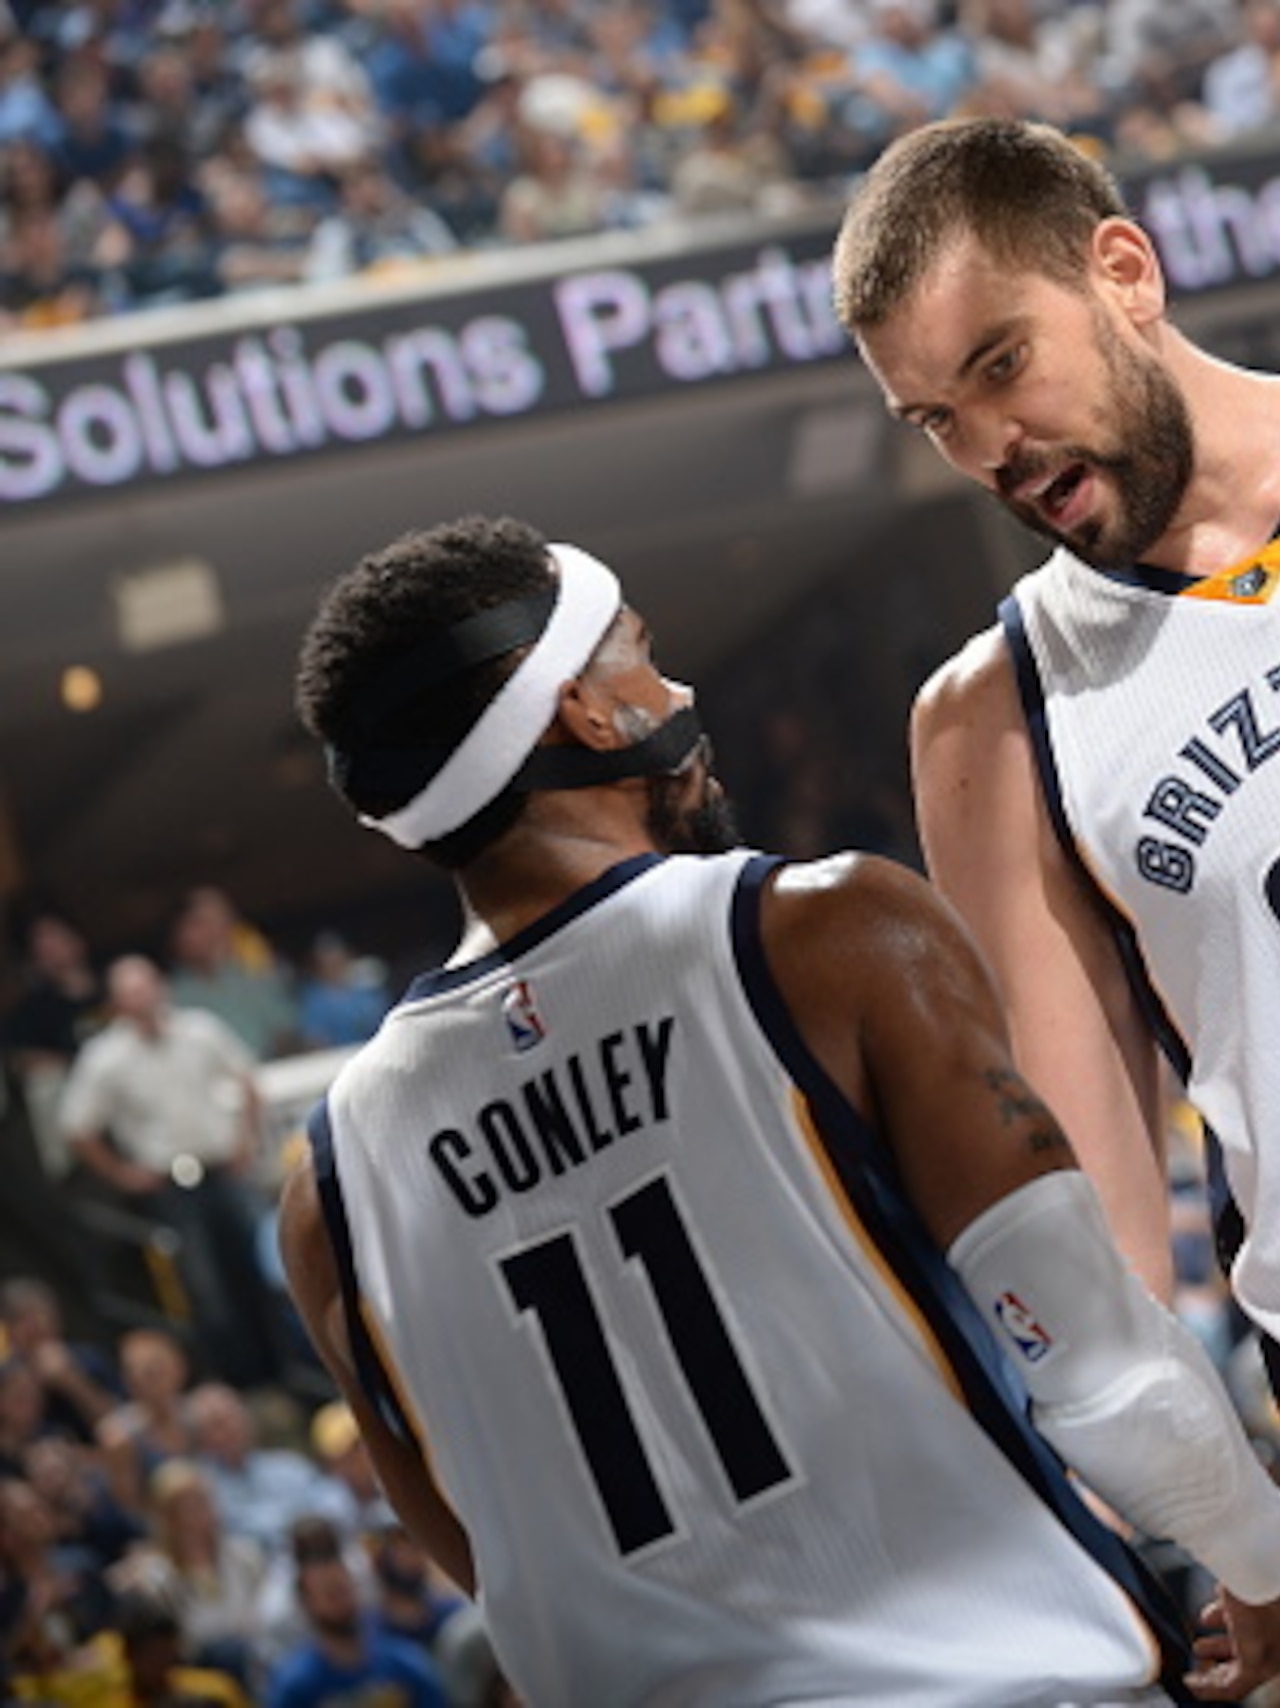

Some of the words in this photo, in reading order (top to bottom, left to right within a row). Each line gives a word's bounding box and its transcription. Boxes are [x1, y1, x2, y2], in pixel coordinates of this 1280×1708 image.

[0, 315, 545, 501] Solutions
[427, 1017, 675, 1218] CONLEY
[497, 1174, 794, 1558] 11
